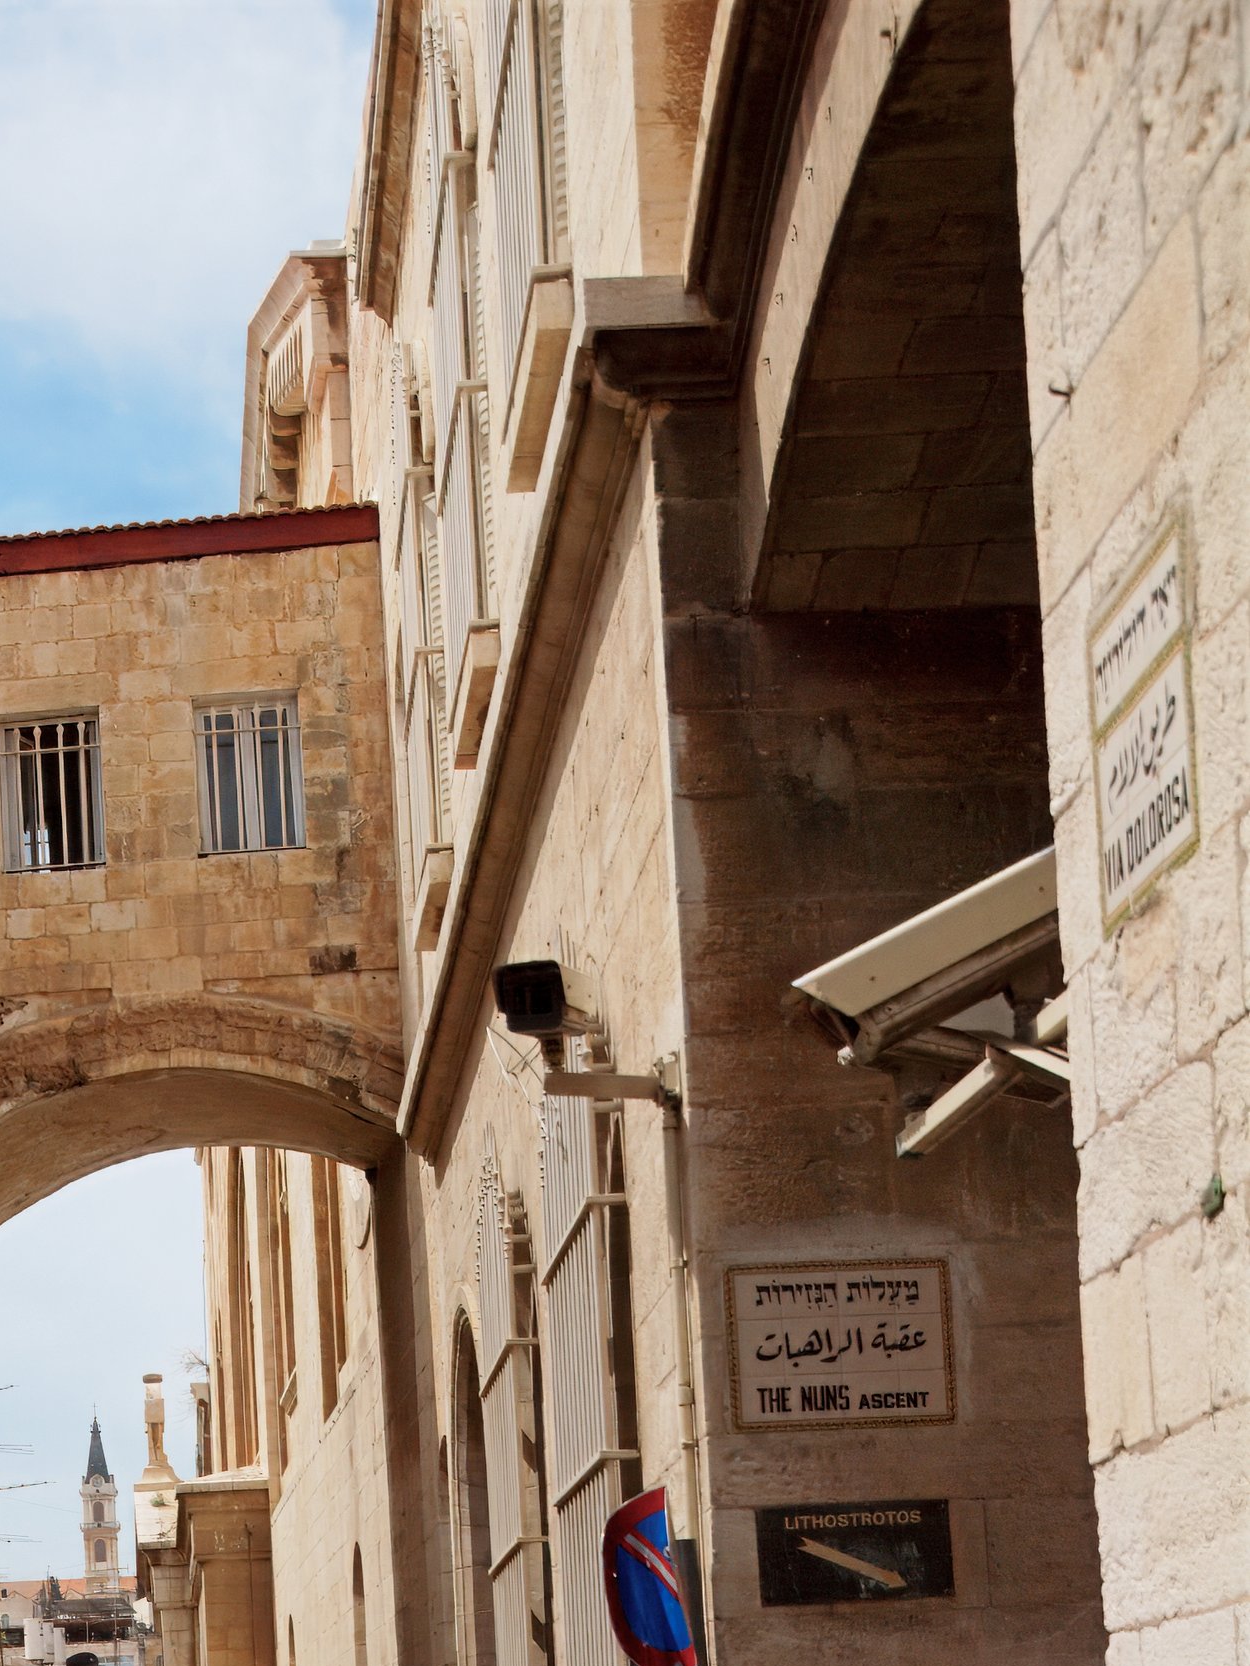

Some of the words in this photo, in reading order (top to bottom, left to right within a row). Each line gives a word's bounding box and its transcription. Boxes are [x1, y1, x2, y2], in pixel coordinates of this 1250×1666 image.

[1104, 836, 1125, 896] VIA
[1126, 765, 1190, 876] DOLOROSA
[756, 1327, 863, 1368] الراهبات
[871, 1322, 927, 1359] عقبة
[756, 1386, 792, 1413] THE
[800, 1384, 850, 1412] NUNS
[858, 1391, 930, 1410] ASCENT
[784, 1509, 923, 1530] LITHOSTROTOS
